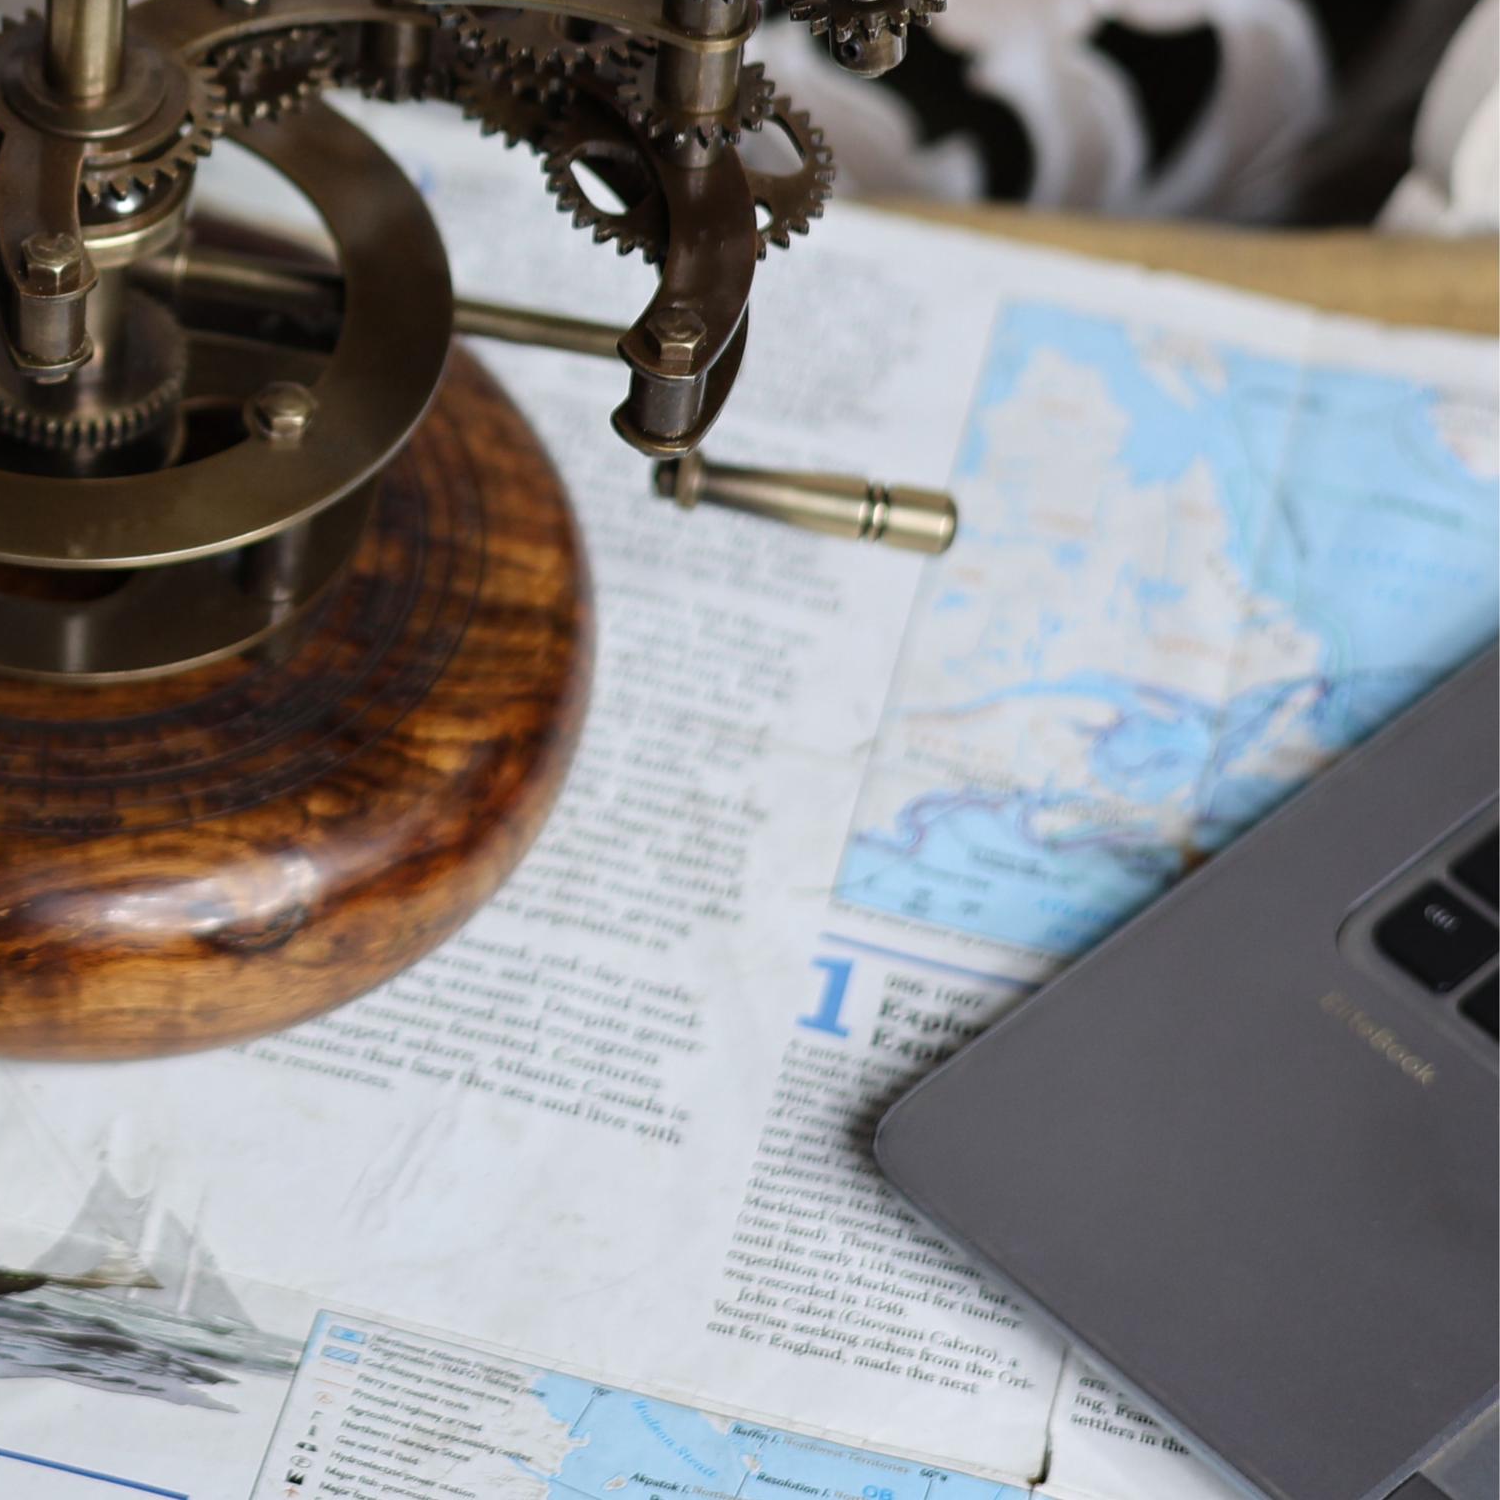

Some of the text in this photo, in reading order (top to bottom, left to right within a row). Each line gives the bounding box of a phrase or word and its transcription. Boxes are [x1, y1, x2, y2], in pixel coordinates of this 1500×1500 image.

[797, 956, 856, 1039] 1
[582, 1078, 665, 1115] Canada
[633, 1121, 684, 1146] with
[736, 1286, 777, 1307] John
[778, 1298, 835, 1319] Cabot
[706, 1322, 735, 1335] ent
[769, 1333, 848, 1364] England,
[853, 1356, 901, 1373] made
[906, 1366, 934, 1381] the
[939, 1376, 977, 1392] next
[715, 1300, 787, 1328] Venetian
[792, 1323, 858, 1347] seeking
[862, 1338, 914, 1357] riches
[918, 1347, 959, 1369] from
[965, 1361, 993, 1378] the
[1070, 1412, 1136, 1440] settlers
[1139, 1430, 1157, 1447] in
[756, 1470, 820, 1496] Resolution
